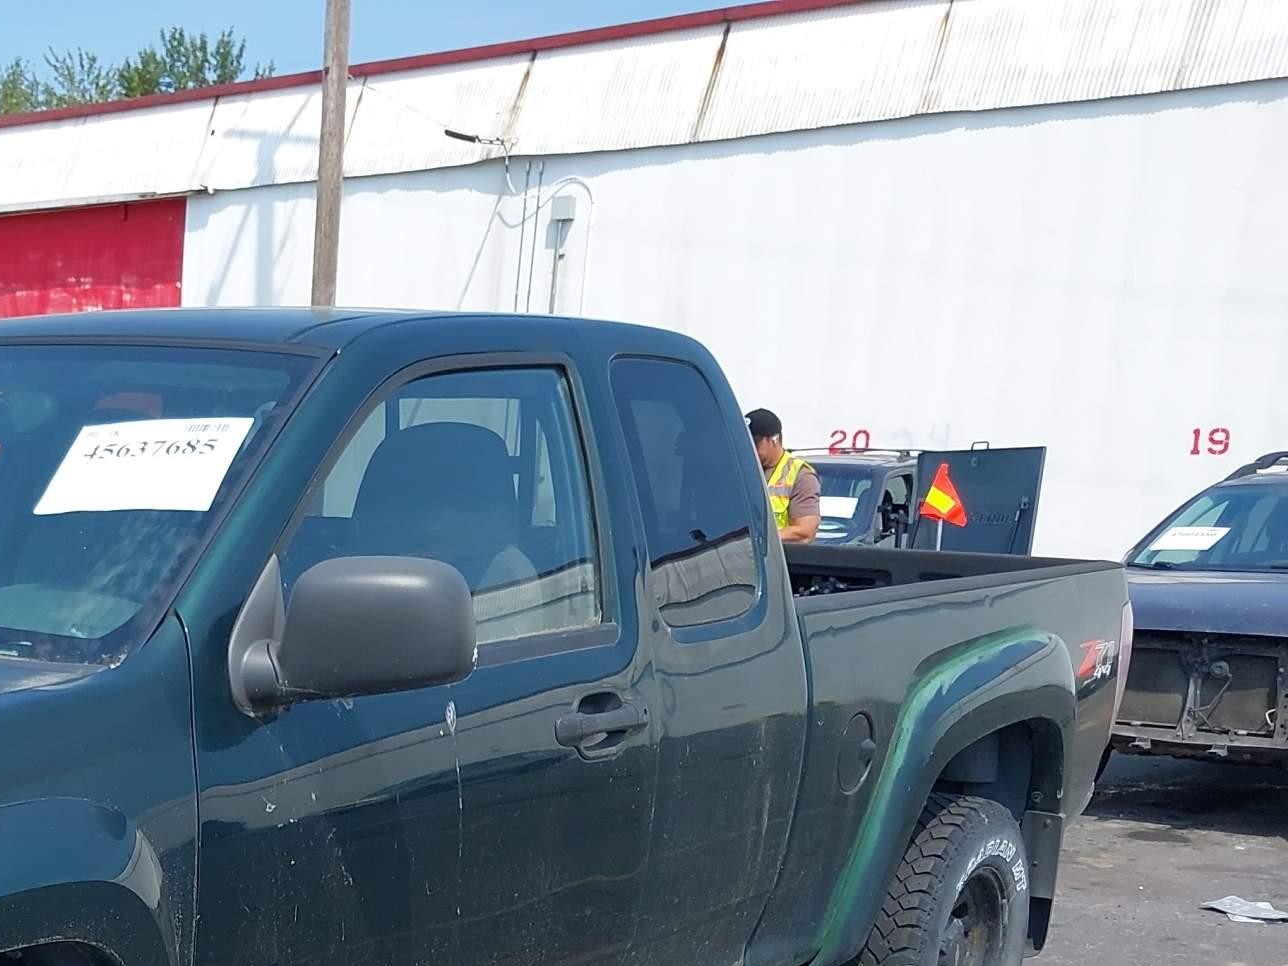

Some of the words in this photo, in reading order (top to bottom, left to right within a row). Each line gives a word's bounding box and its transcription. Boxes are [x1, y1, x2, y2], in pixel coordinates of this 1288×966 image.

[83, 438, 219, 460] 45637685
[829, 429, 870, 454] 20
[1190, 428, 1230, 455] 19
